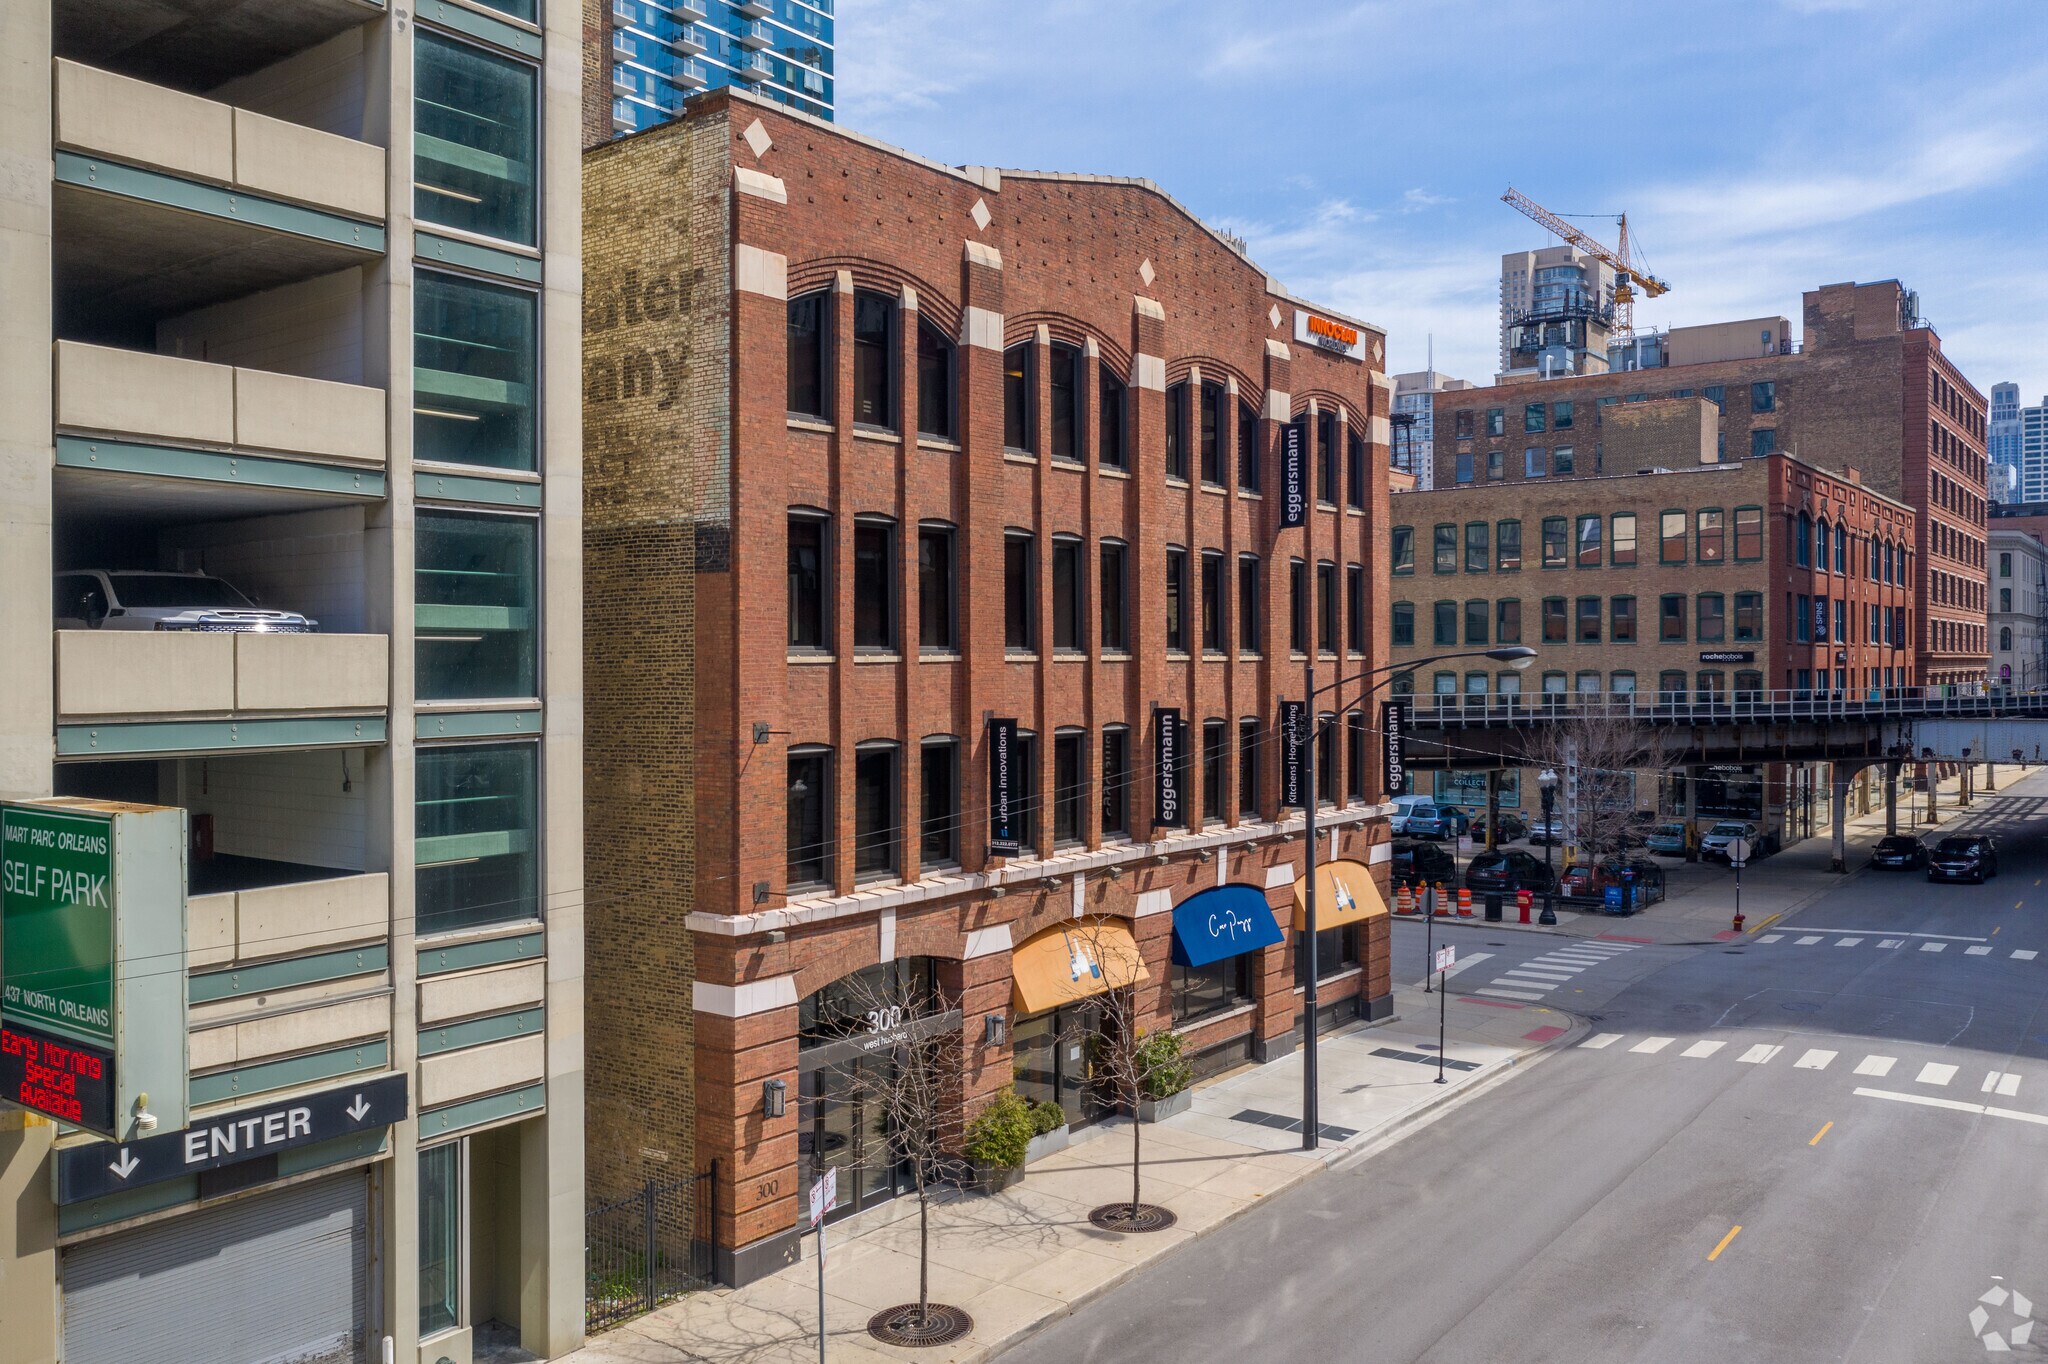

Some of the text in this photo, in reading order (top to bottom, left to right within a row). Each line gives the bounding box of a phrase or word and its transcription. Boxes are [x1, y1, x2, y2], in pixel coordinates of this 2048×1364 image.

[582, 268, 704, 333] ater
[1308, 315, 1358, 345] INNOCEAN
[1287, 428, 1302, 522] eggersmann
[1815, 601, 1823, 624] SPINS
[1288, 704, 1299, 732] Living
[1288, 733, 1297, 760] Home
[1388, 706, 1402, 790] eggersmann
[998, 726, 1008, 822] urban innovations
[1162, 715, 1177, 821] eggersmann
[1288, 765, 1297, 804] Kitchens
[5, 825, 107, 855] MART PARC ORLEANS
[4, 860, 108, 908] SELF PARK
[5, 985, 108, 1027] 437 NORTH ORLEANS
[867, 1005, 901, 1034] 300
[2, 1029, 101, 1079] Early Morning
[864, 1036, 880, 1050] west
[26, 1060, 75, 1095] Special
[20, 1081, 81, 1121] Available
[184, 1106, 311, 1164] ENTER
[756, 1179, 779, 1201] 300
